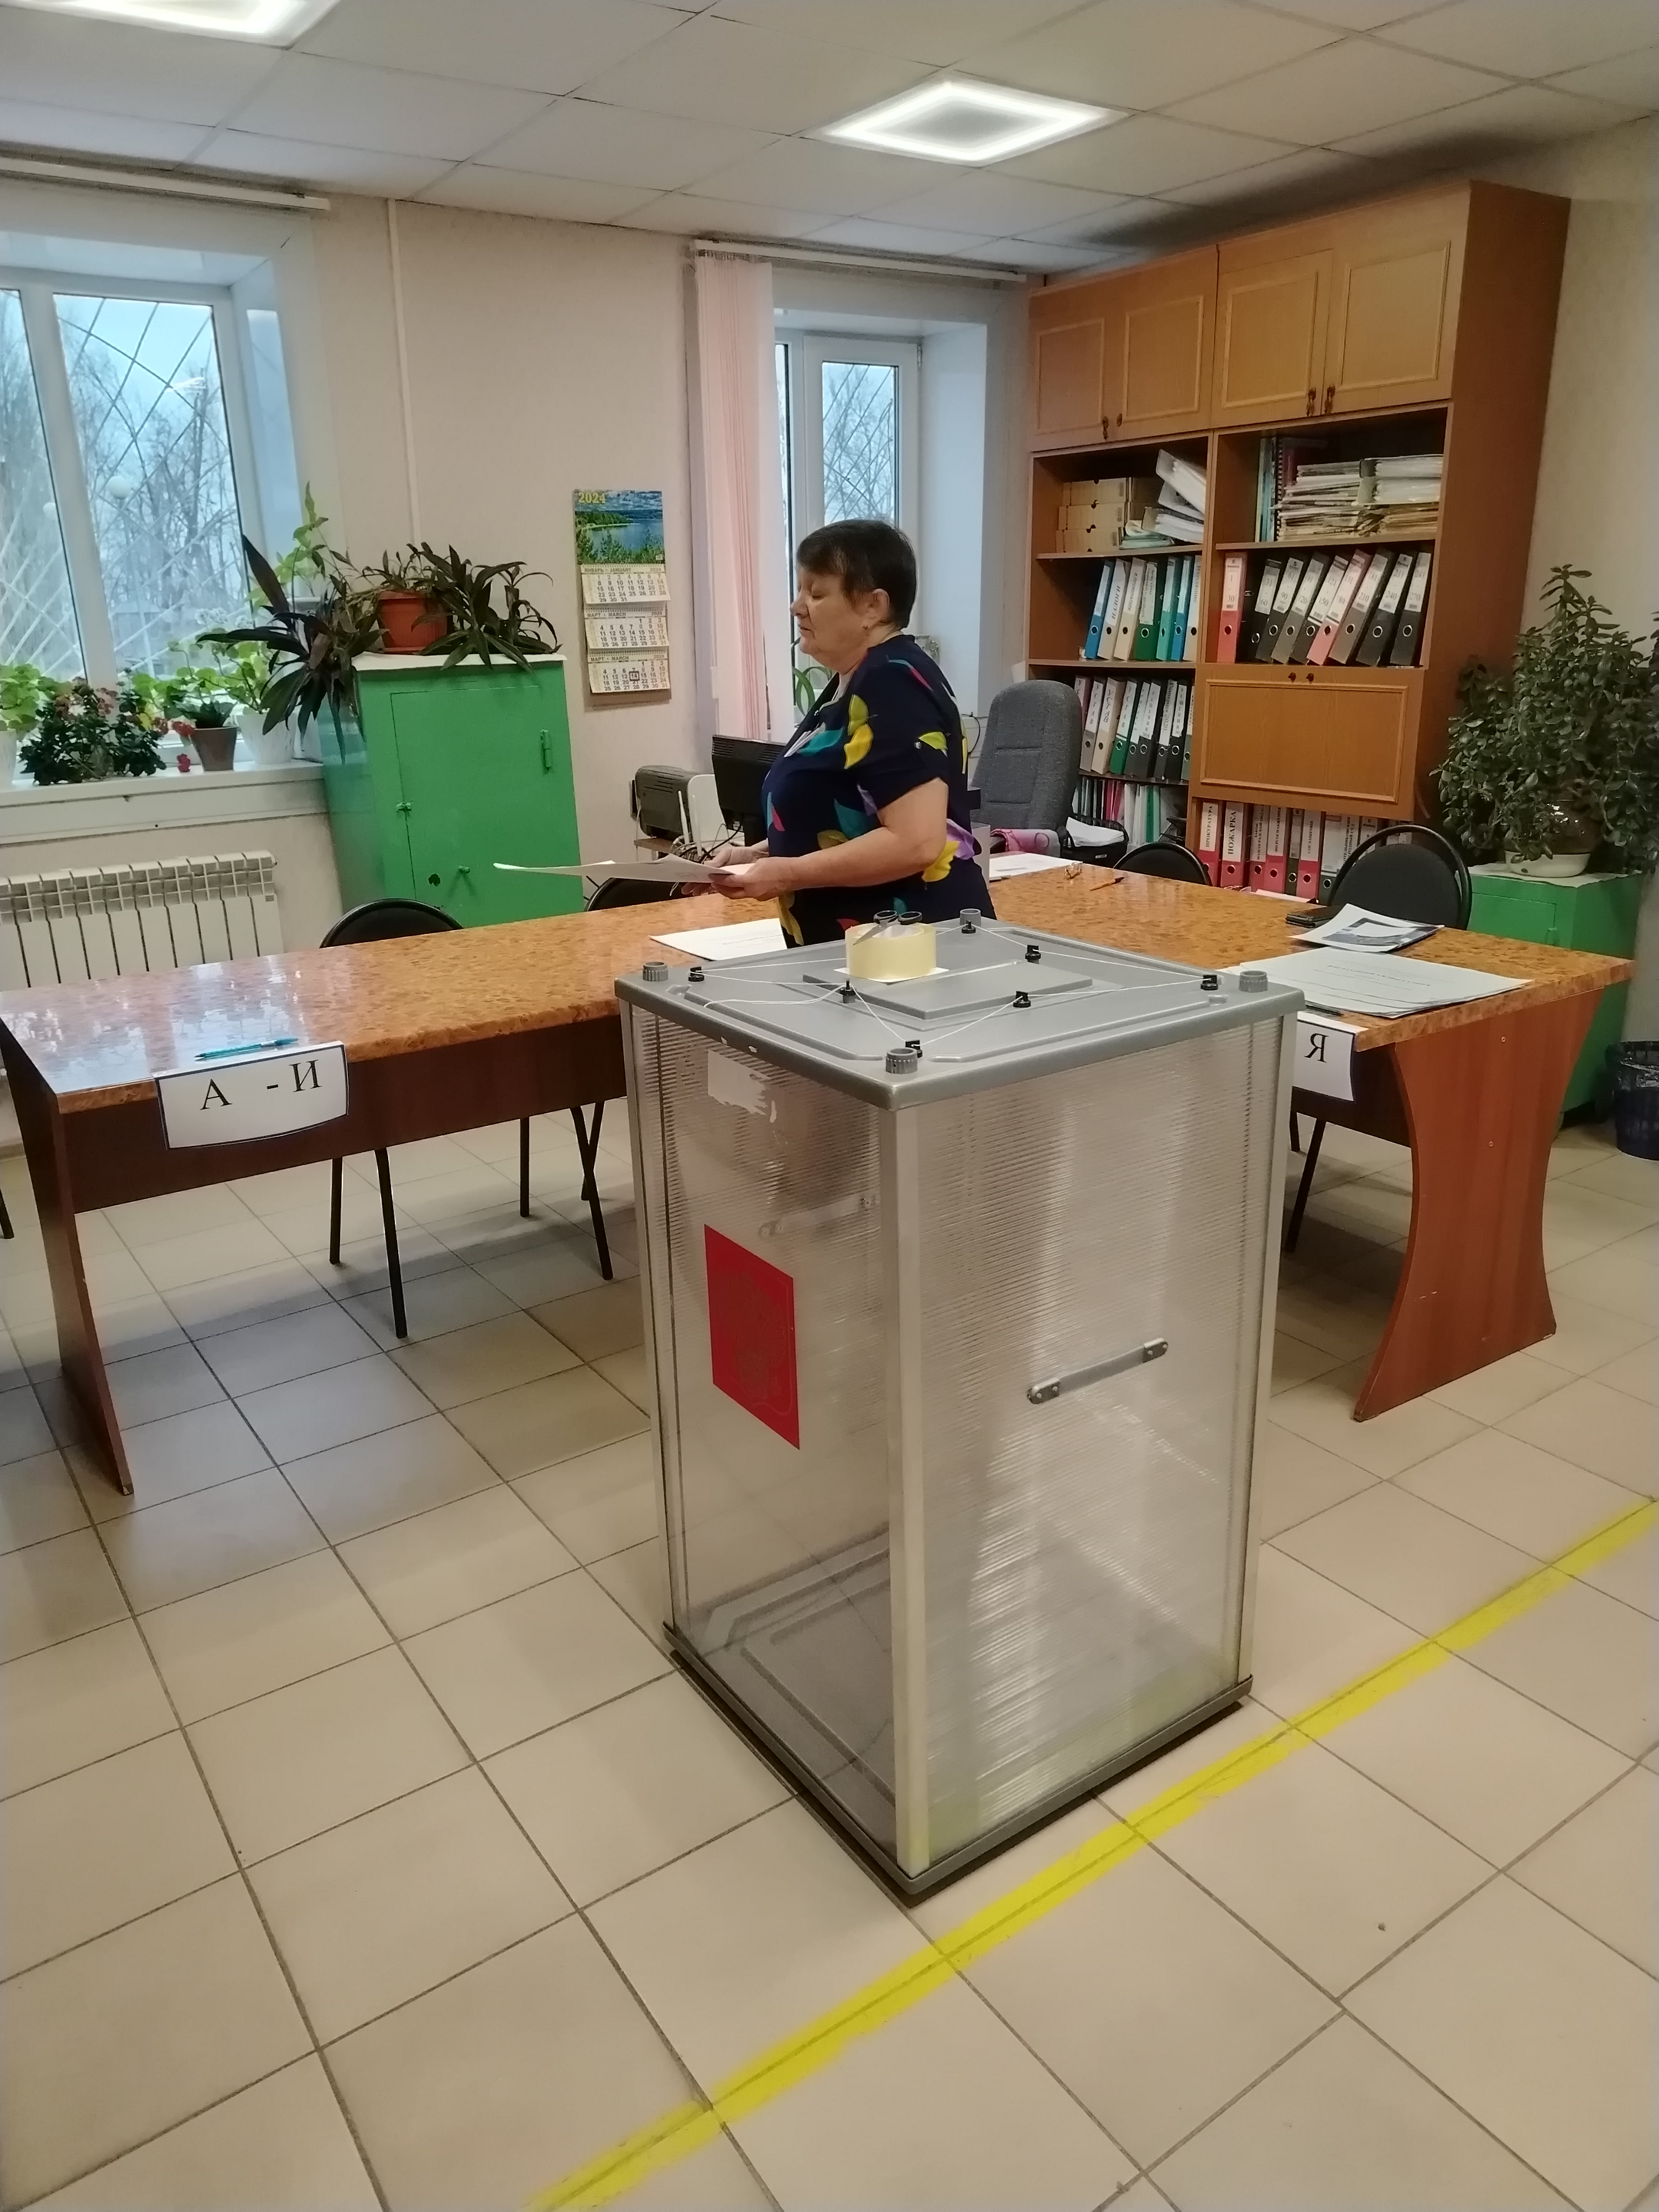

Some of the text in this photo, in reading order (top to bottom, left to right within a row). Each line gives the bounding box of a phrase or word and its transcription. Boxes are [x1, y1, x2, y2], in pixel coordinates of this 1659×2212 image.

[578, 492, 606, 504] 2024
[1394, 570, 1404, 578] 211
[1415, 570, 1425, 578] 241
[1328, 576, 1337, 586] 121
[1319, 597, 1328, 606] 150
[1359, 593, 1369, 602] 210
[1385, 591, 1397, 600] 240
[1089, 684, 1099, 724] УСТАВ
[1103, 689, 1114, 723] УСТАВ
[1121, 686, 1132, 728] УСТАВ
[1228, 811, 1237, 855] ПОЖАРКА
[1304, 1032, 1329, 1063] Я
[200, 1078, 233, 1110] А
[288, 1059, 322, 1092] И
